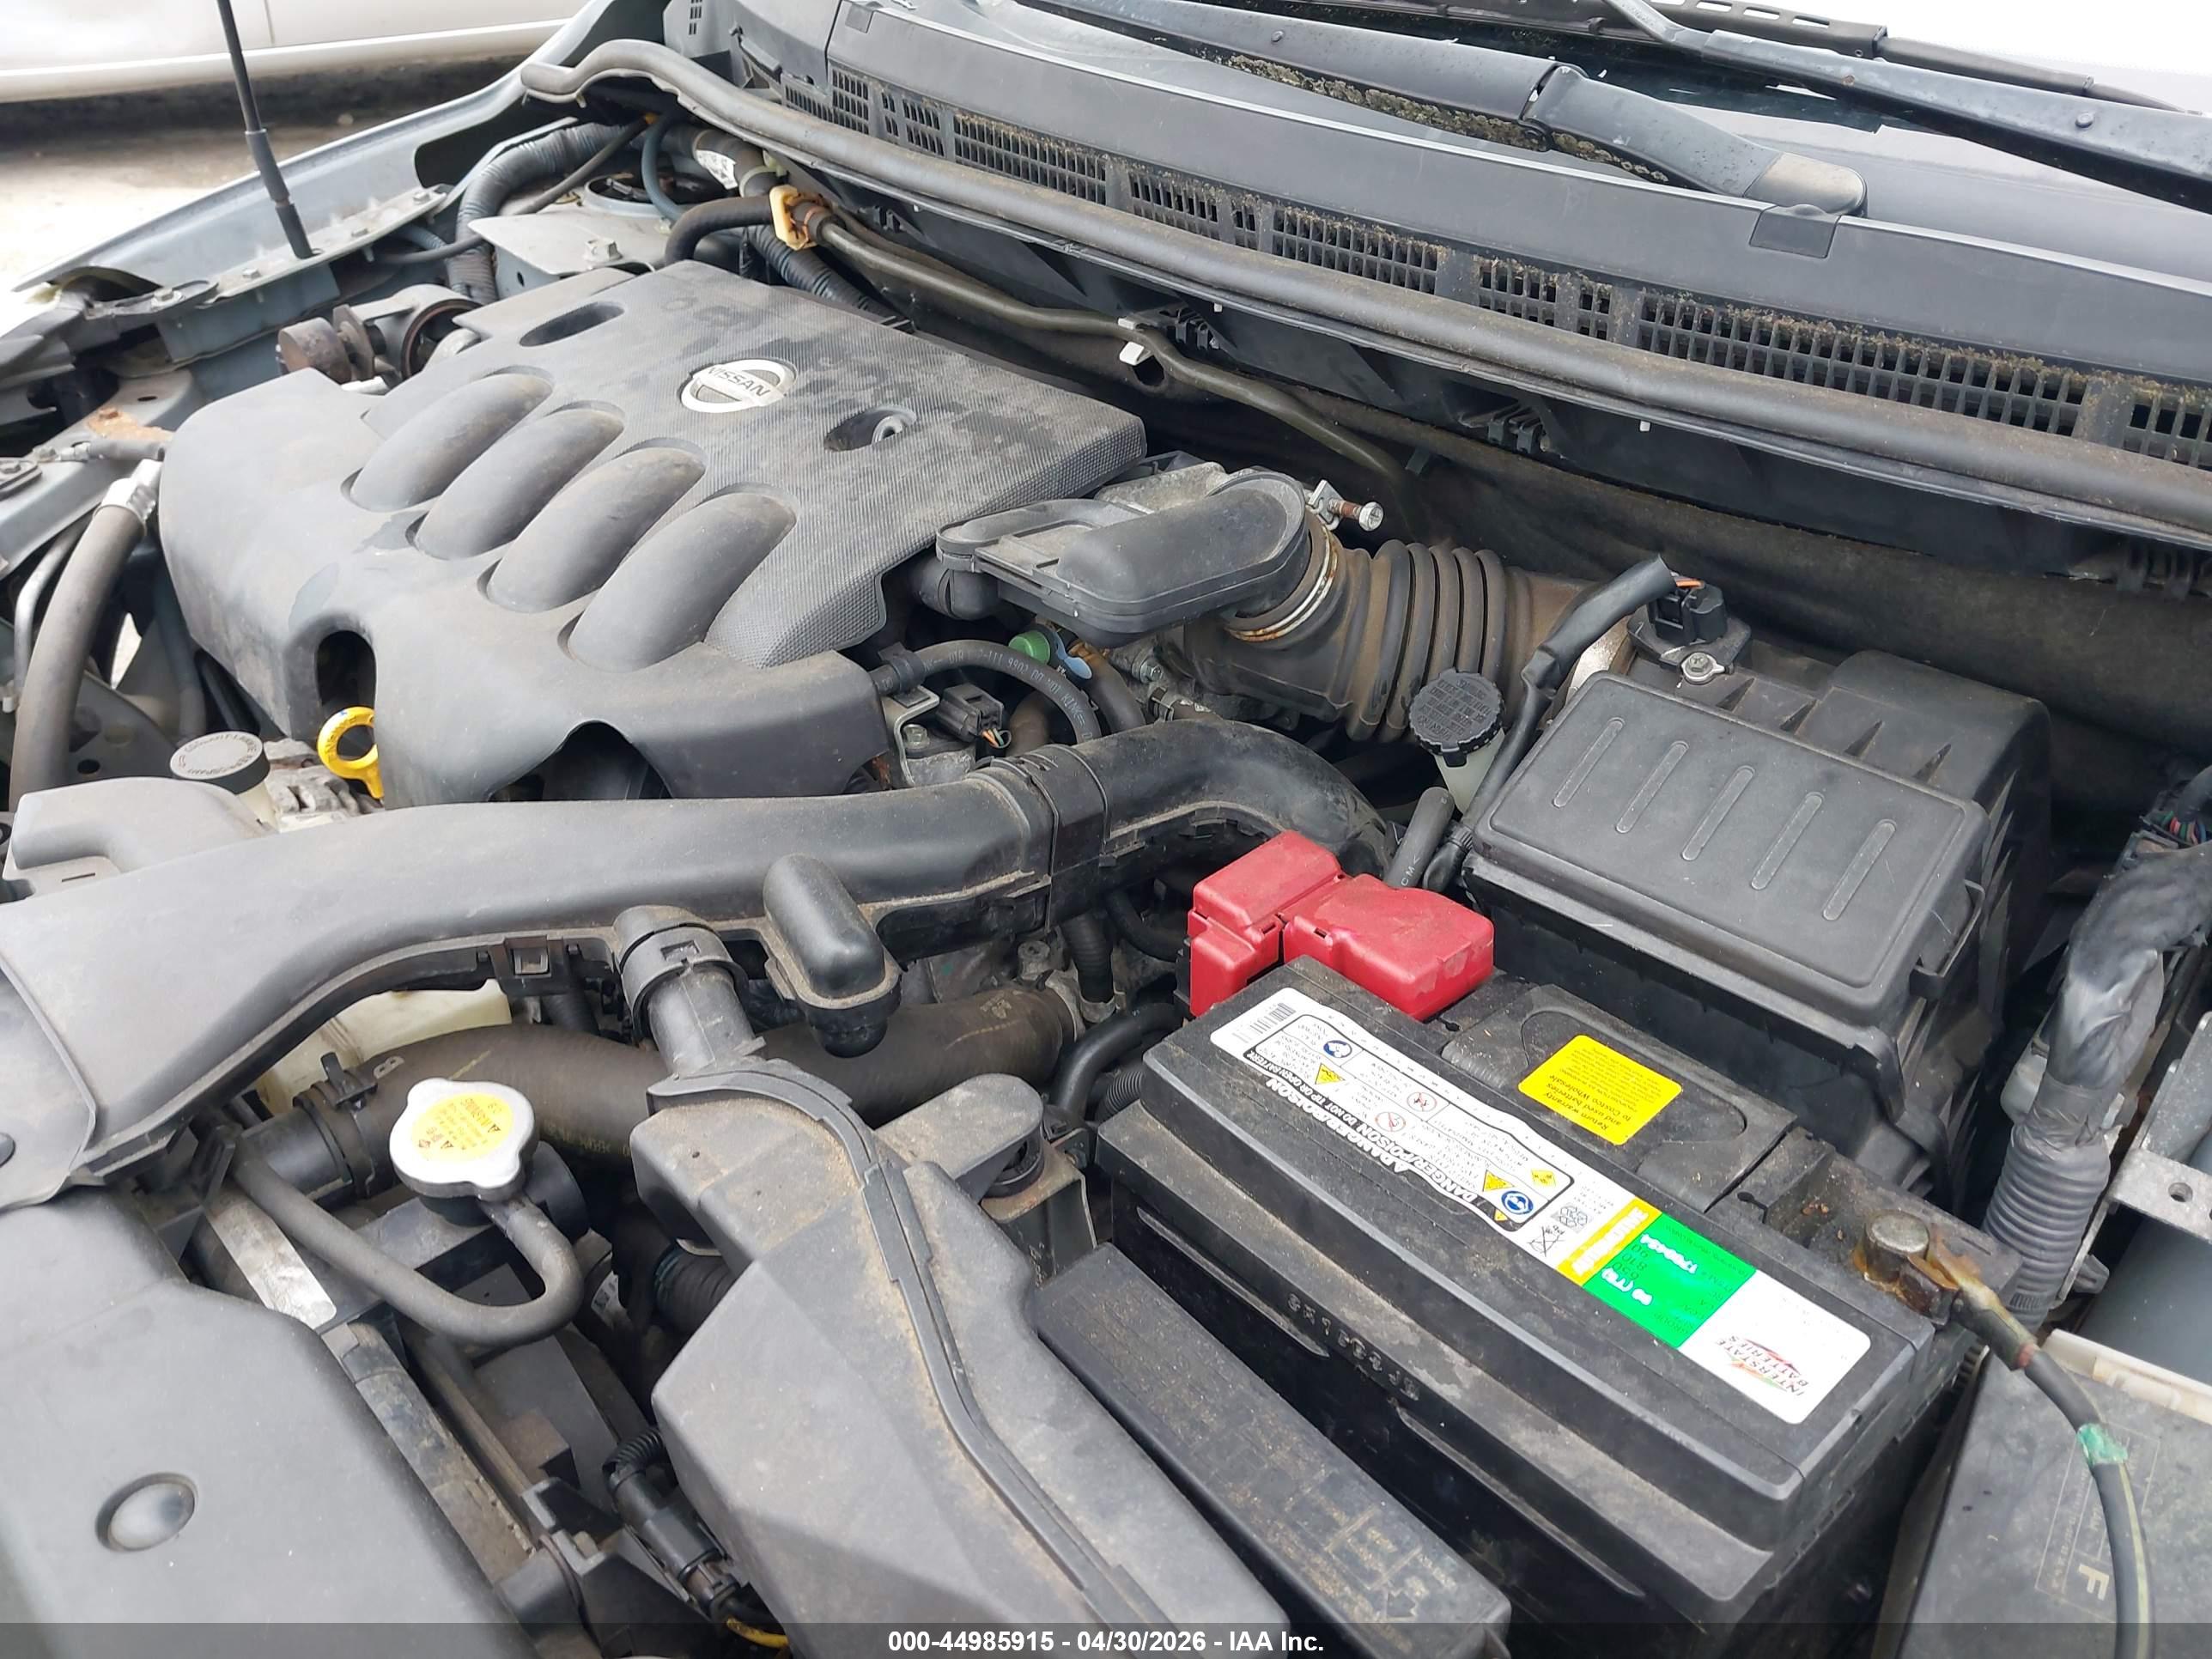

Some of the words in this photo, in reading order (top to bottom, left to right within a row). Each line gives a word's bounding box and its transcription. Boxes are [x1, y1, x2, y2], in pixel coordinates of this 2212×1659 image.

[708, 367, 771, 396] NISSAN
[1278, 1068, 1302, 1086] OPEN
[1547, 1073, 1591, 1100] Wholesale
[1298, 1083, 1313, 1095] OR
[1310, 1092, 1326, 1105] TIP
[1544, 1082, 1583, 1106] batteries
[1325, 1102, 1345, 1116] NOT
[1543, 1091, 1581, 1114] warranty
[1583, 1103, 1604, 1116] used
[1589, 1097, 1621, 1116] Costco
[1342, 1113, 1357, 1125] DO
[1578, 1111, 1609, 1130] Return
[1603, 1115, 1621, 1127] and
[1356, 1122, 1477, 1203] DANGER/POISON
[1611, 1261, 1639, 1279] 650
[1620, 1251, 1647, 1272] 810
[1713, 1337, 1806, 1396] INTERSTATE
[1726, 1334, 1810, 1388] BATTERIES
